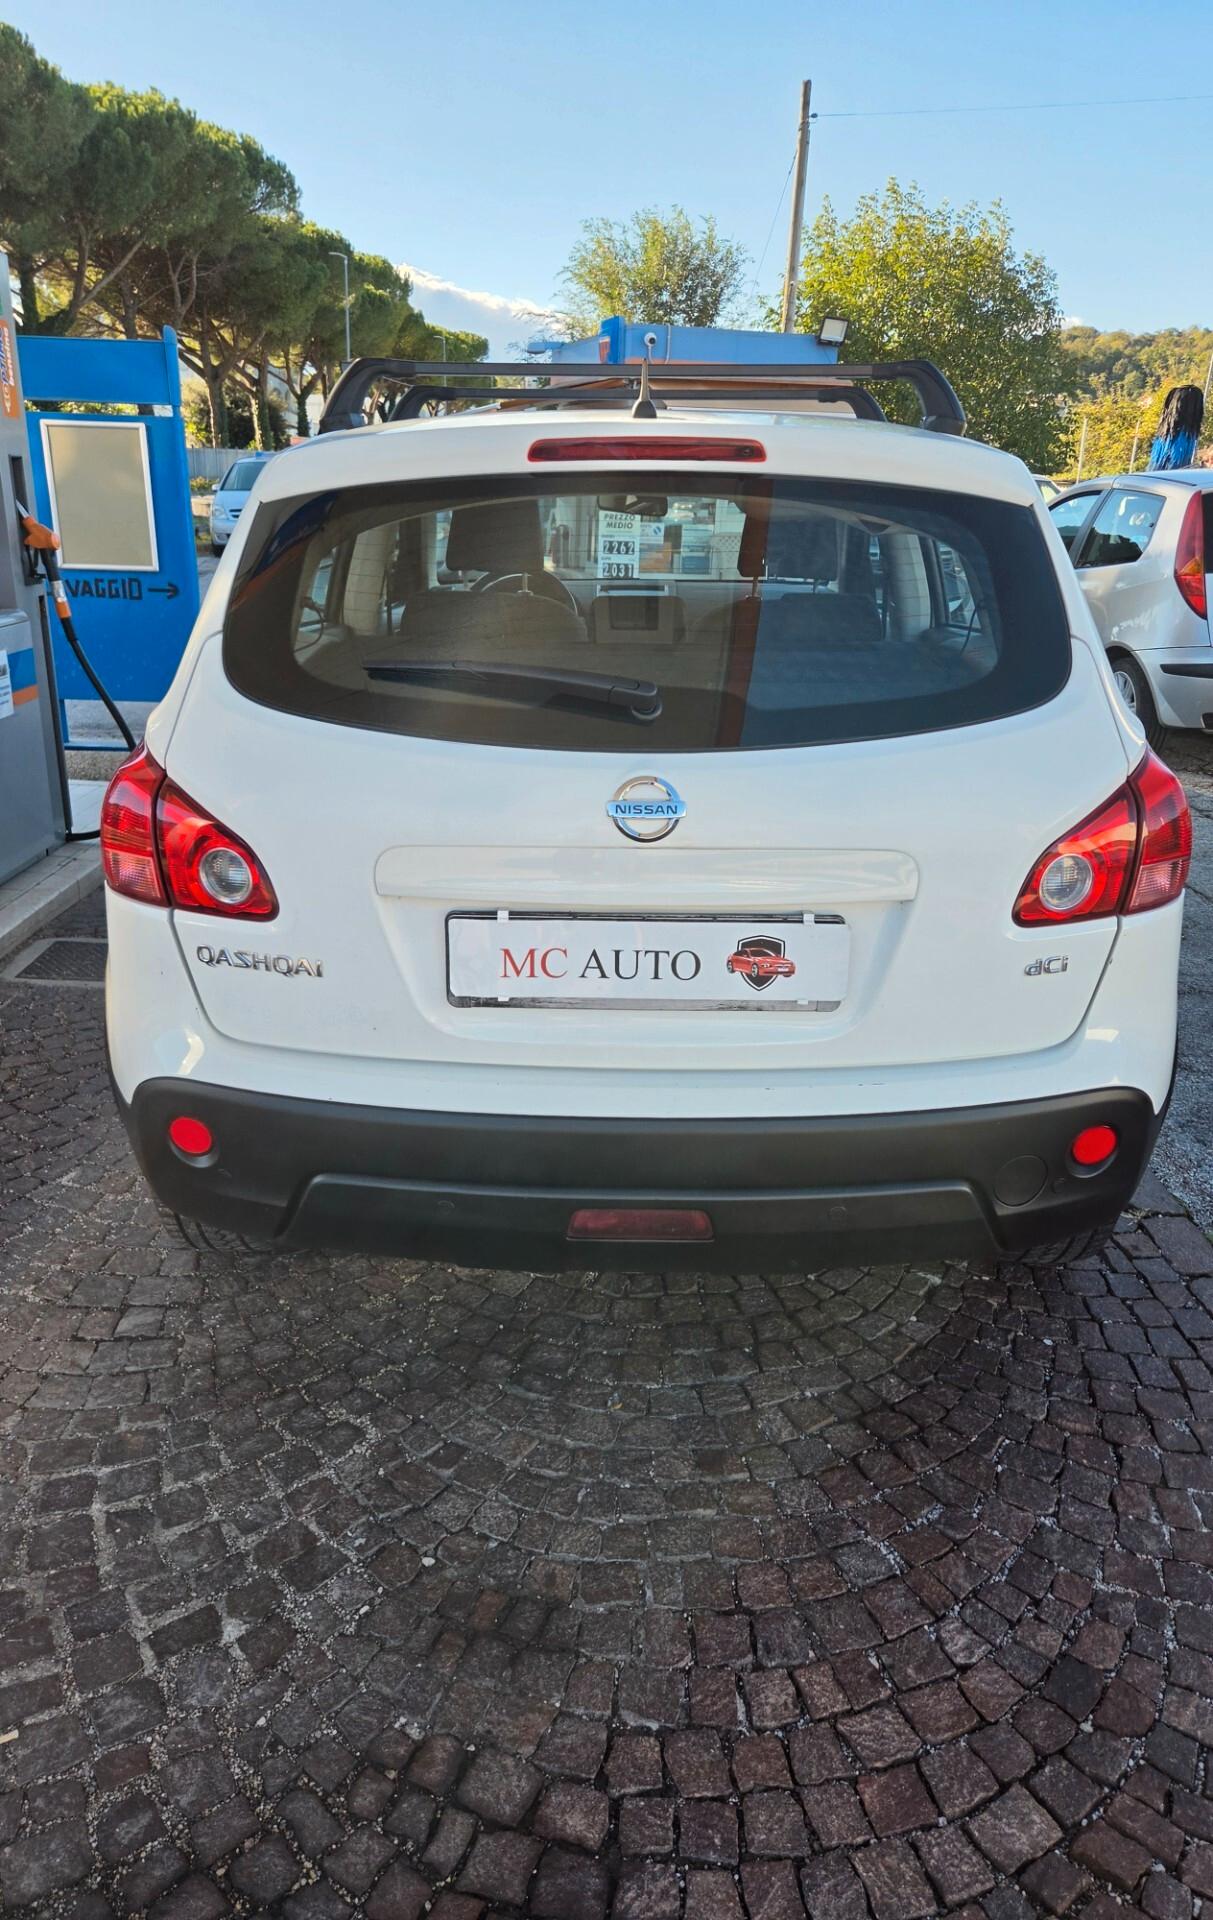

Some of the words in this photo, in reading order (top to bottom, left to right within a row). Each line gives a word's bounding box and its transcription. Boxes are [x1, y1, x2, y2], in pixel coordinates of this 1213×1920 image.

[604, 513, 636, 522] PREZZO
[606, 521, 634, 530] MEDIO
[603, 542, 634, 554] 2262
[603, 565, 633, 578] 2031
[48, 578, 143, 601] VAGGIO
[615, 804, 678, 815] NISSAN
[196, 944, 324, 978] QASHQAI
[500, 947, 569, 979] MC
[579, 948, 702, 981] AUTO
[1024, 955, 1069, 976] dCi
